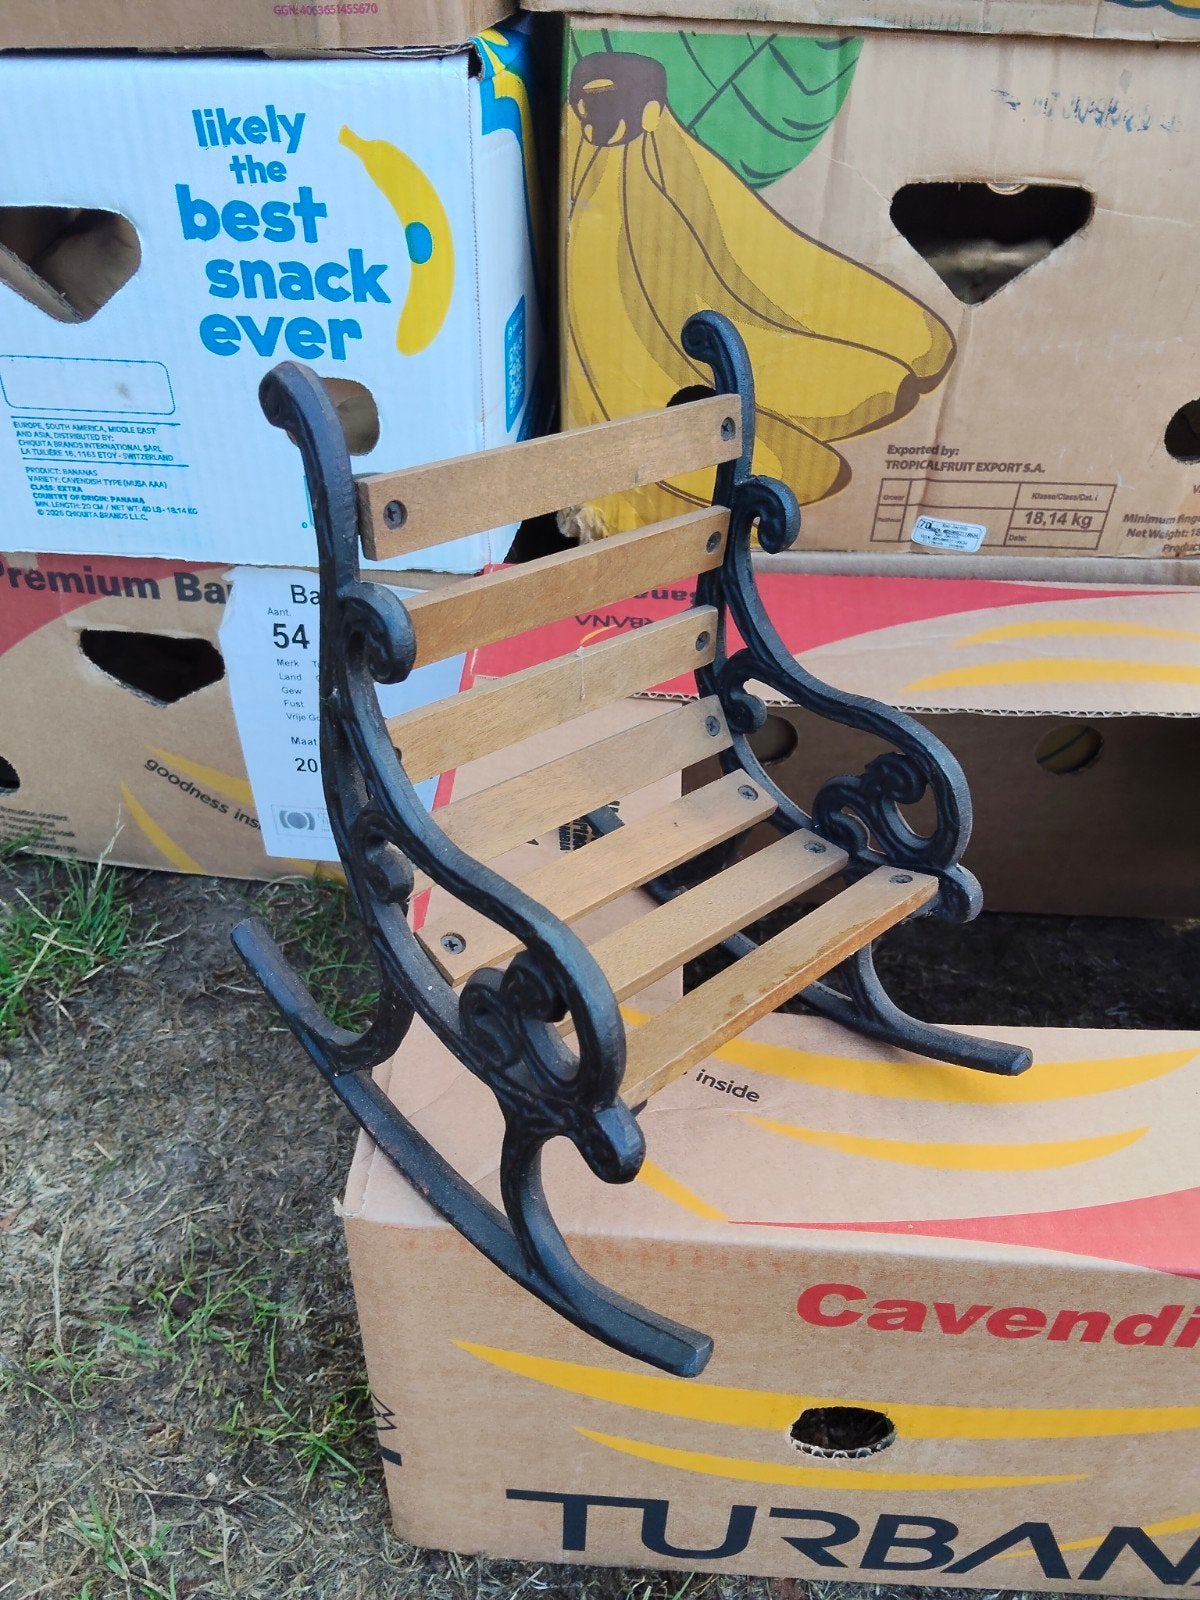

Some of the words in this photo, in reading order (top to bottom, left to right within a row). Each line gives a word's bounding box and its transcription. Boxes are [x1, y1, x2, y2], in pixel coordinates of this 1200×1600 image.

[192, 104, 306, 154] likely
[229, 154, 287, 184] the
[175, 183, 328, 243] best
[205, 248, 392, 303] snack
[199, 314, 362, 360] ever
[16, 430, 32, 438] AND
[54, 432, 100, 440] DISTRIBUTED
[102, 434, 115, 442] BY:
[108, 426, 136, 434] MIDDLE
[18, 440, 52, 448] CHIQUITA
[54, 441, 83, 449] BRANDS
[84, 442, 142, 452] INTERNATIONAL
[887, 444, 939, 457] Exported
[940, 445, 960, 458] by:
[122, 452, 174, 461] SWITZERLAND
[26, 466, 61, 474] PRODUCT:
[62, 468, 98, 476] BANANAS
[976, 462, 1022, 473] EXPORT
[1023, 462, 1046, 474] S.A.
[28, 475, 61, 483] VARIETY:
[62, 476, 102, 484] CAVENDISH
[32, 492, 68, 500] COUNTRY
[110, 496, 146, 504] PANAMA
[65, 510, 98, 518] CHIQUITA
[99, 512, 129, 520] BRANDS
[1025, 511, 1068, 526] 18,14
[1071, 512, 1093, 529] kg
[1123, 513, 1176, 524] Minimum
[1126, 528, 1148, 538] Net
[1148, 529, 1189, 541] Weight:
[174, 572, 234, 605] Ba
[575, 615, 656, 630] BANA
[272, 622, 311, 650] 54
[276, 658, 300, 668] Merk
[279, 673, 302, 682] Land
[281, 686, 303, 695] Gew
[283, 699, 305, 708] Fust
[286, 712, 307, 722] Vrije
[290, 736, 318, 747] Maat
[294, 757, 319, 773] 20
[144, 759, 230, 814] goodness
[695, 1068, 760, 1103] inside
[796, 1283, 1200, 1349] Cavendi
[505, 1489, 1200, 1586] TURBAN
